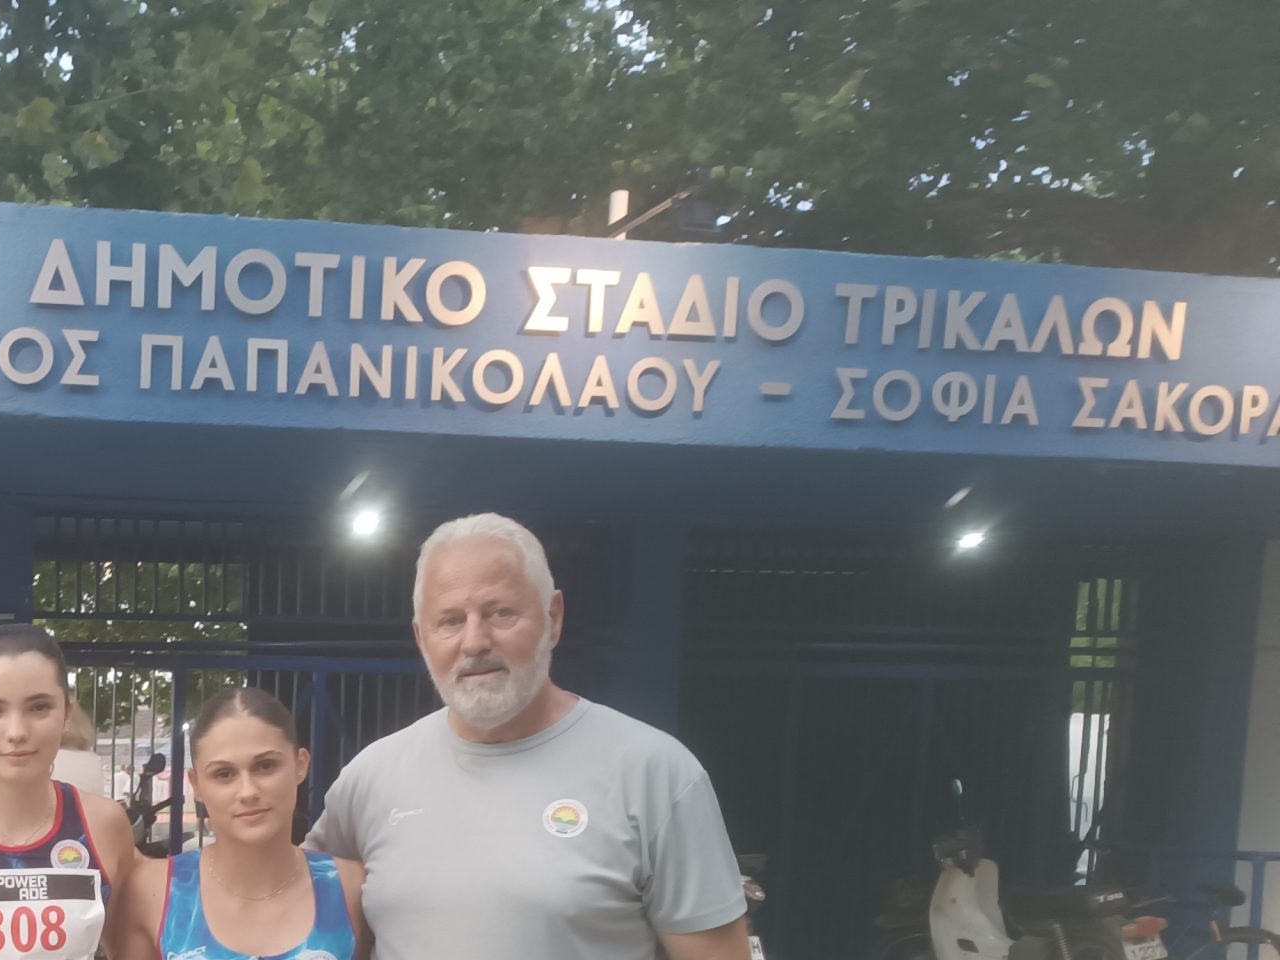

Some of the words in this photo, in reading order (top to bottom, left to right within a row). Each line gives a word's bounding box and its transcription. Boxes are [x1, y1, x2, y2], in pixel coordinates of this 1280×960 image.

[29, 238, 487, 326] ΔΗΜΟΤΙΚΟ
[523, 266, 805, 342] ΣΤΑΔΙΟ
[835, 282, 1187, 361] ΤΡΙΚΑΛΩΝ
[139, 333, 720, 412] ΠΑΠΑΝΙΚΟΛΑΟΥ
[830, 367, 1039, 426] ΣΟΦΙΑ
[19, 887, 48, 900] ADE
